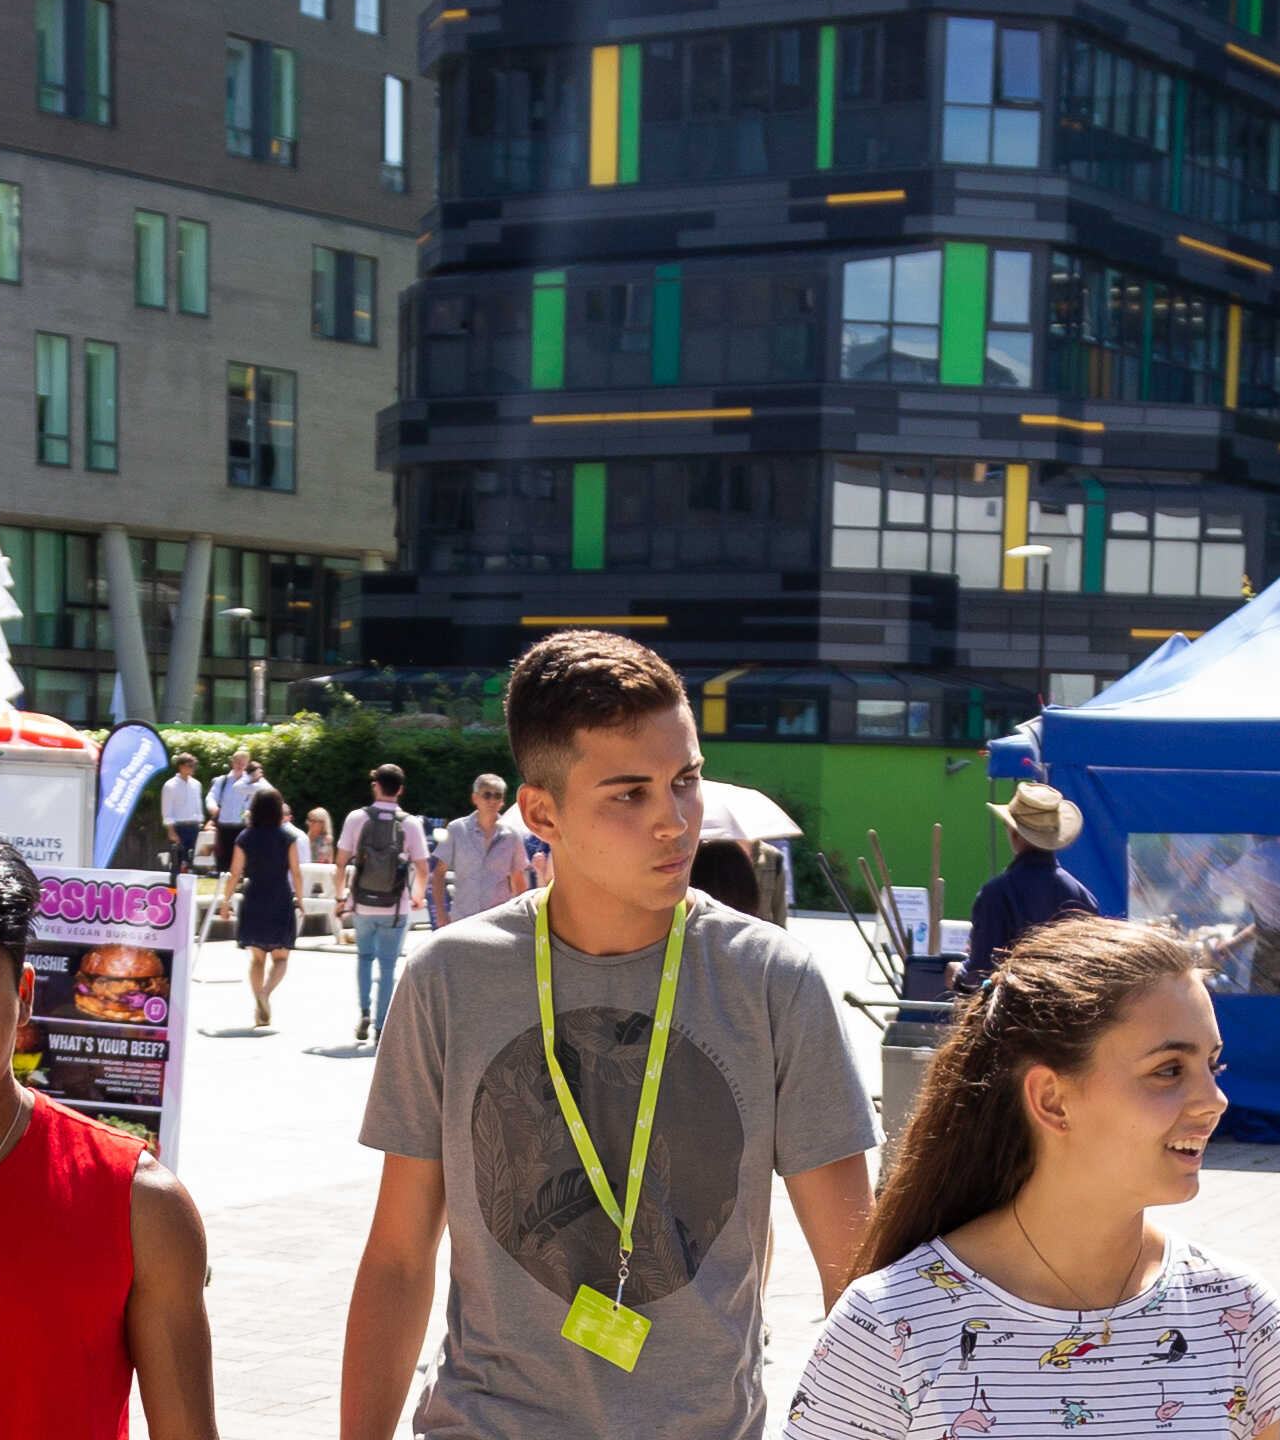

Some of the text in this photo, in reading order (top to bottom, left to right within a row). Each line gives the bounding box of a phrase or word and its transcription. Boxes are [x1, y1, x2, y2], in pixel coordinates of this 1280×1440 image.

[34, 877, 176, 929] OSHIES
[68, 926, 101, 937] VEGAN
[106, 929, 159, 942] BURGERS
[48, 1033, 166, 1058] WHAT'S YOUR BEEF?
